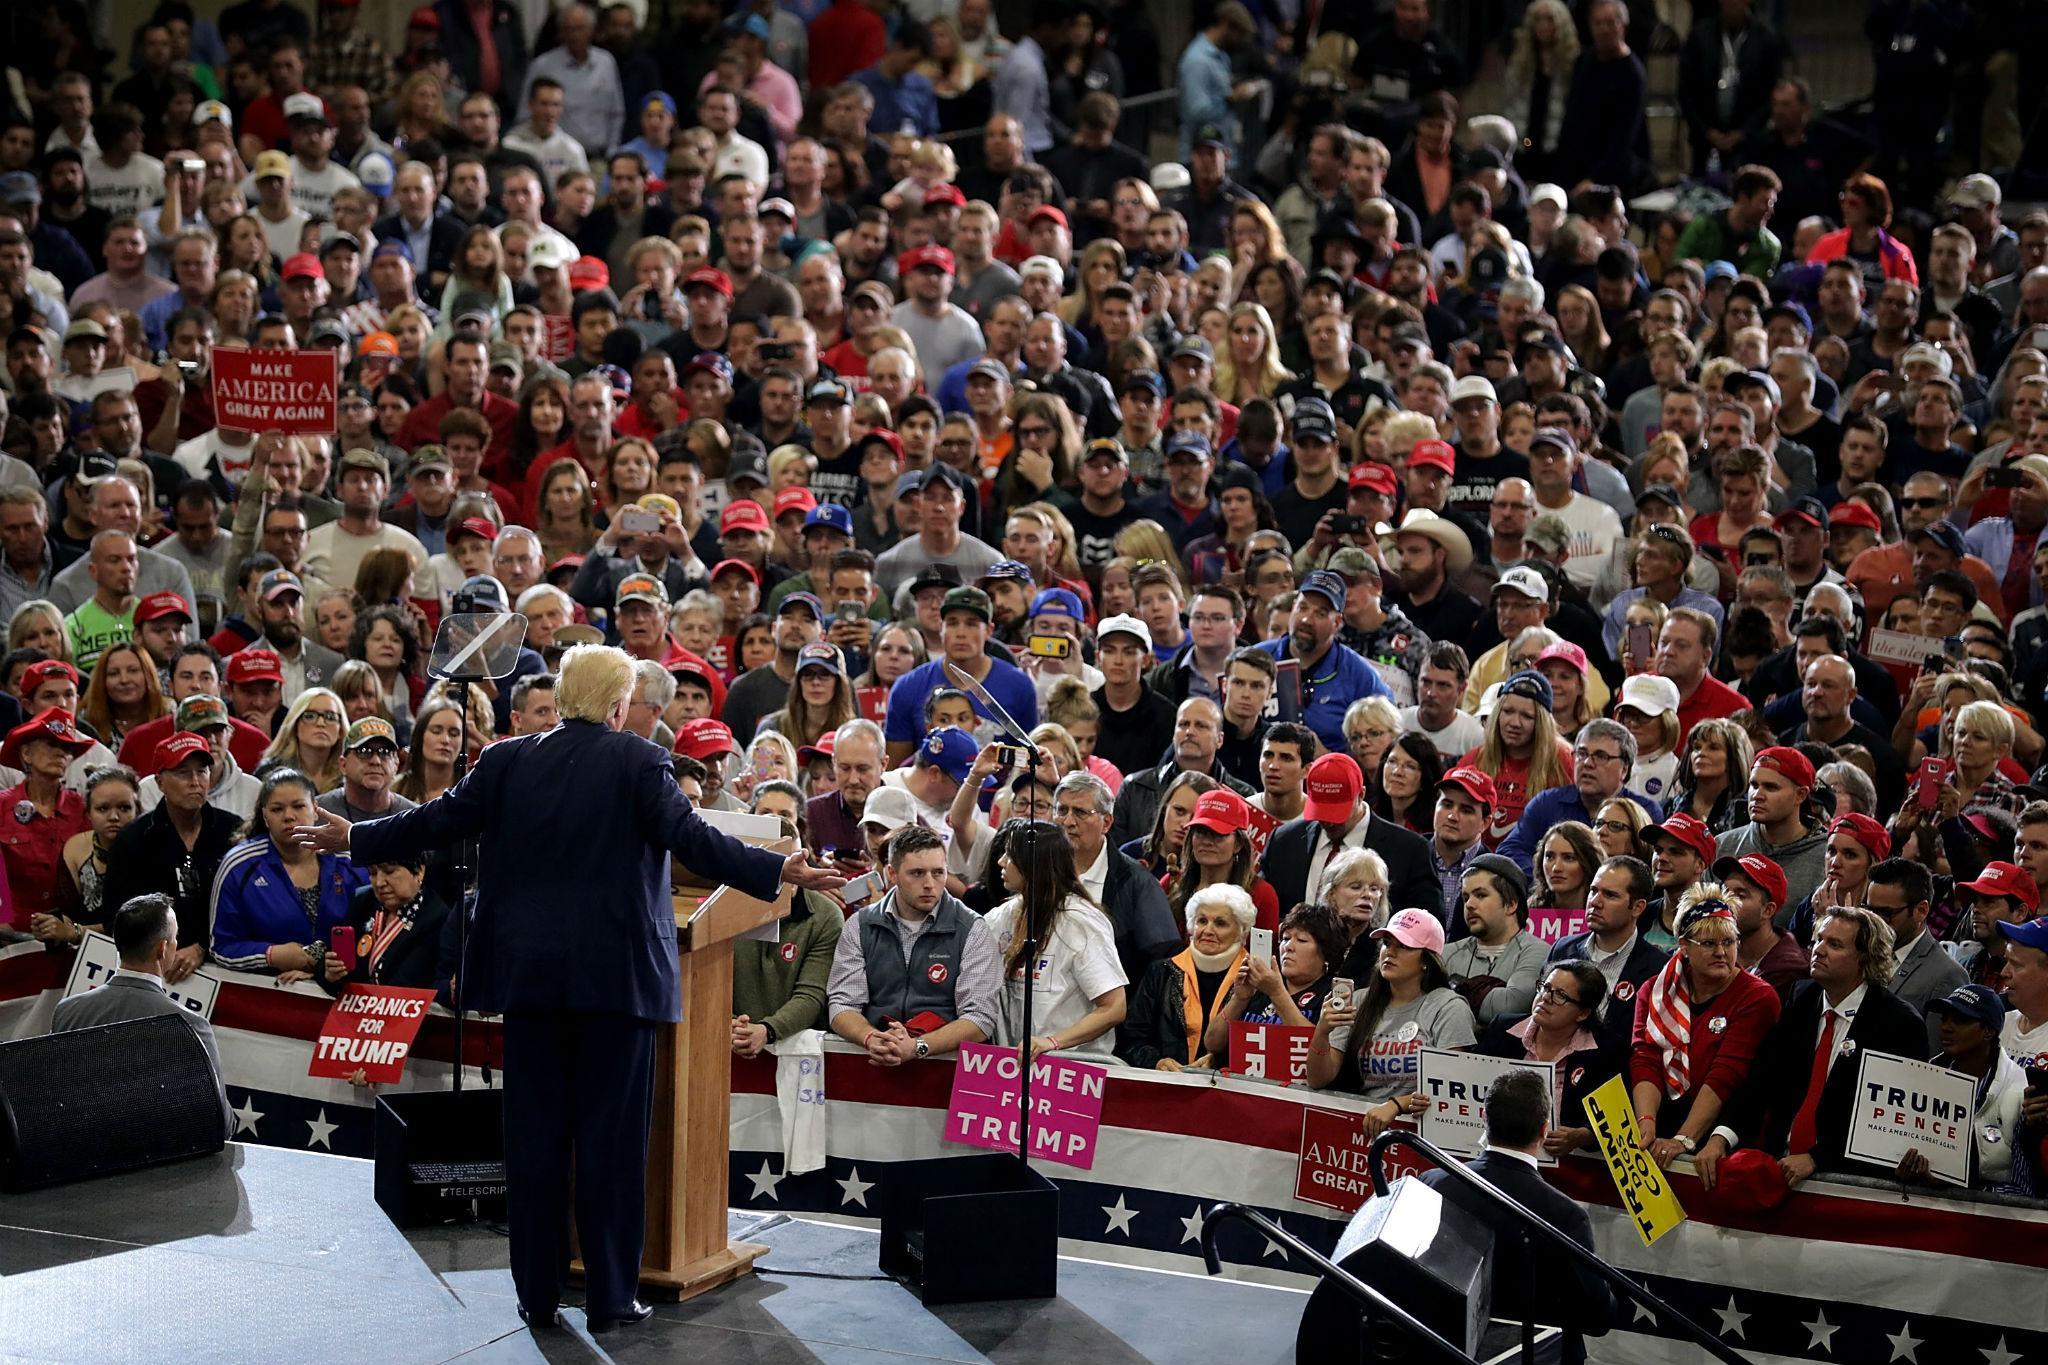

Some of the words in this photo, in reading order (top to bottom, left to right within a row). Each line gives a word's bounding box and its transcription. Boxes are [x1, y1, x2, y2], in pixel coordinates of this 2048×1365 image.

[252, 362, 293, 380] MAKE
[217, 377, 334, 404] AMERICA
[225, 400, 271, 420] GREAT
[274, 404, 325, 421] AGAIN
[1874, 641, 1895, 655] the
[337, 994, 425, 1018] HISPANICS
[357, 1018, 385, 1034] FOR
[318, 1036, 408, 1065] TRUMP
[961, 1049, 1103, 1101] WOMEN
[1867, 1082, 1967, 1124] TRUMP
[957, 1112, 1087, 1156] TRUMP
[1435, 1117, 1453, 1126] MAKE
[1867, 1123, 1887, 1134] MAKE
[1889, 1127, 1920, 1141] AMERICA
[1921, 1133, 1938, 1146] GREAT
[1872, 1107, 1957, 1141] PENCE
[1615, 1133, 1642, 1193] DIGS
[1623, 1108, 1662, 1198] COAL
[1587, 1096, 1653, 1241] TRUMP
[1312, 1170, 1368, 1196] GREAT
